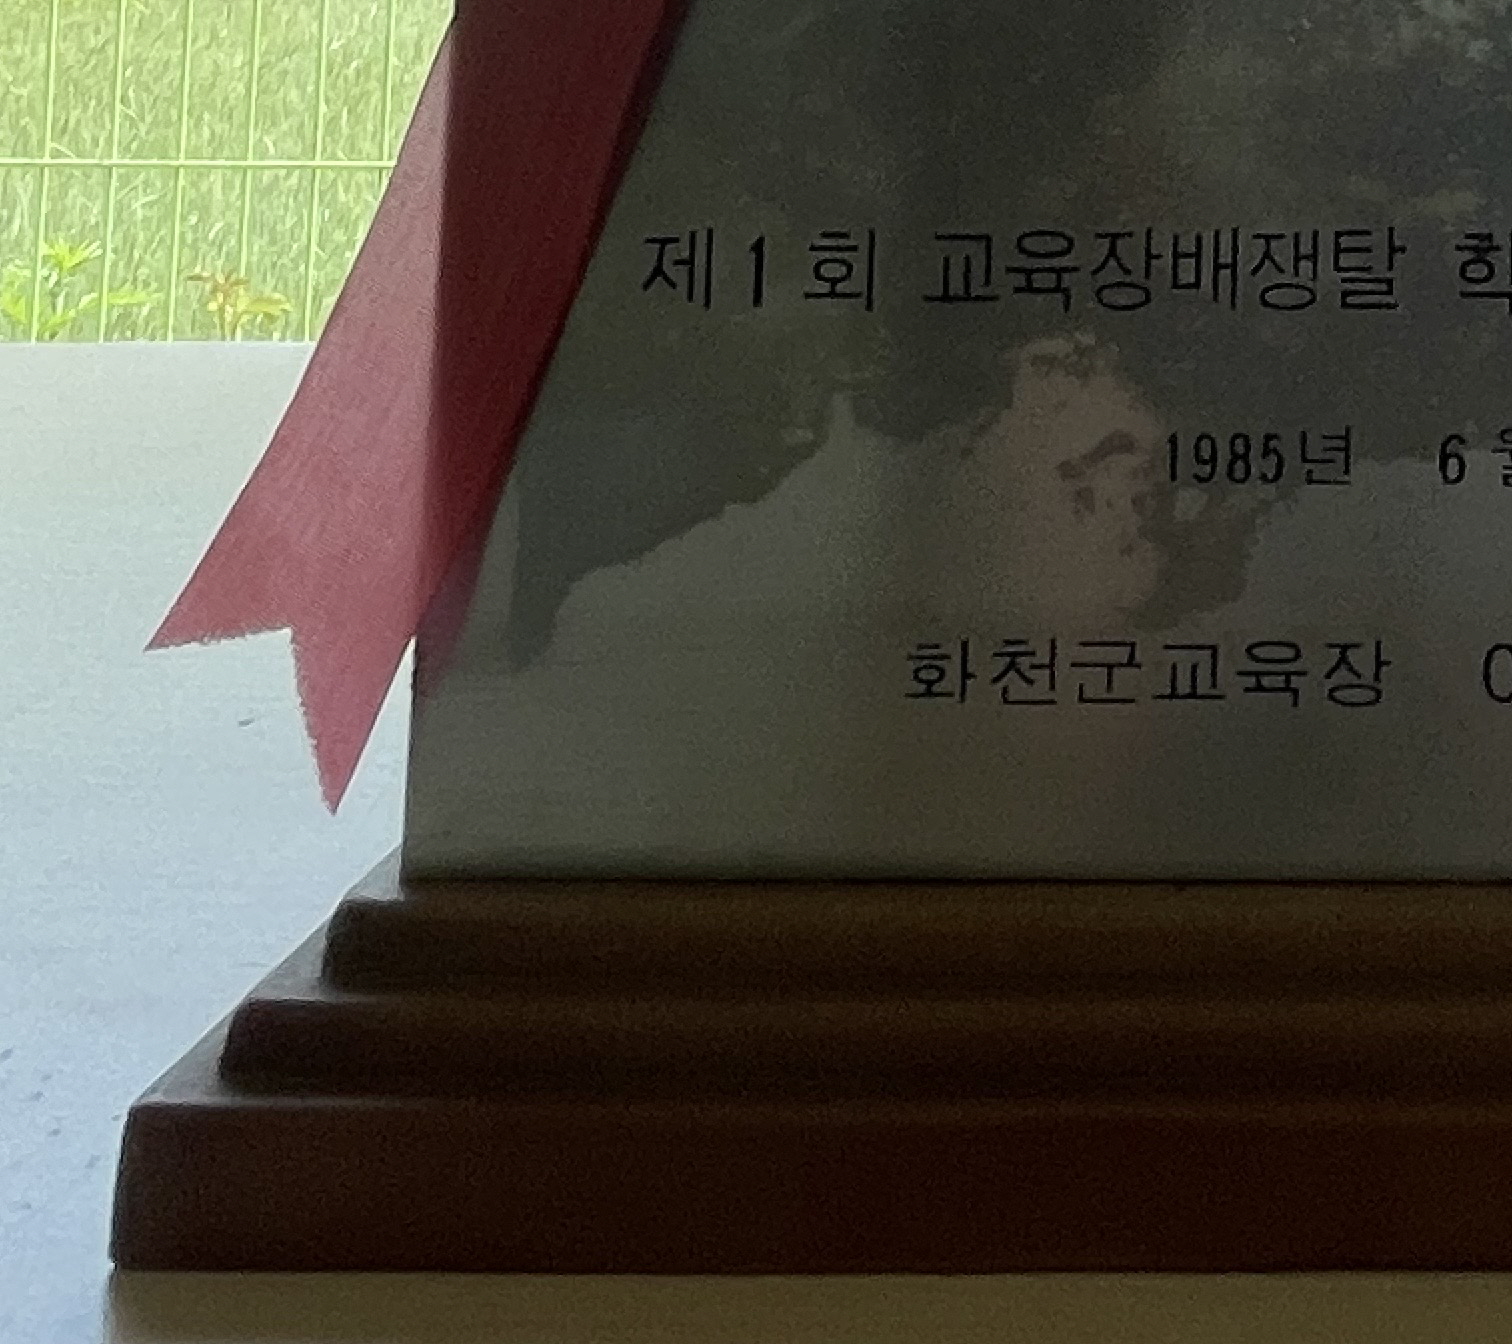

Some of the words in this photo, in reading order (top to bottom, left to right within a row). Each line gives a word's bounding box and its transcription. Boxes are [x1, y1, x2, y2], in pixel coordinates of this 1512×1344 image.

[923, 225, 1407, 313] 교육장배쟁탈
[1167, 425, 1352, 486] 1985년
[904, 636, 1393, 707] 화천군교육장
